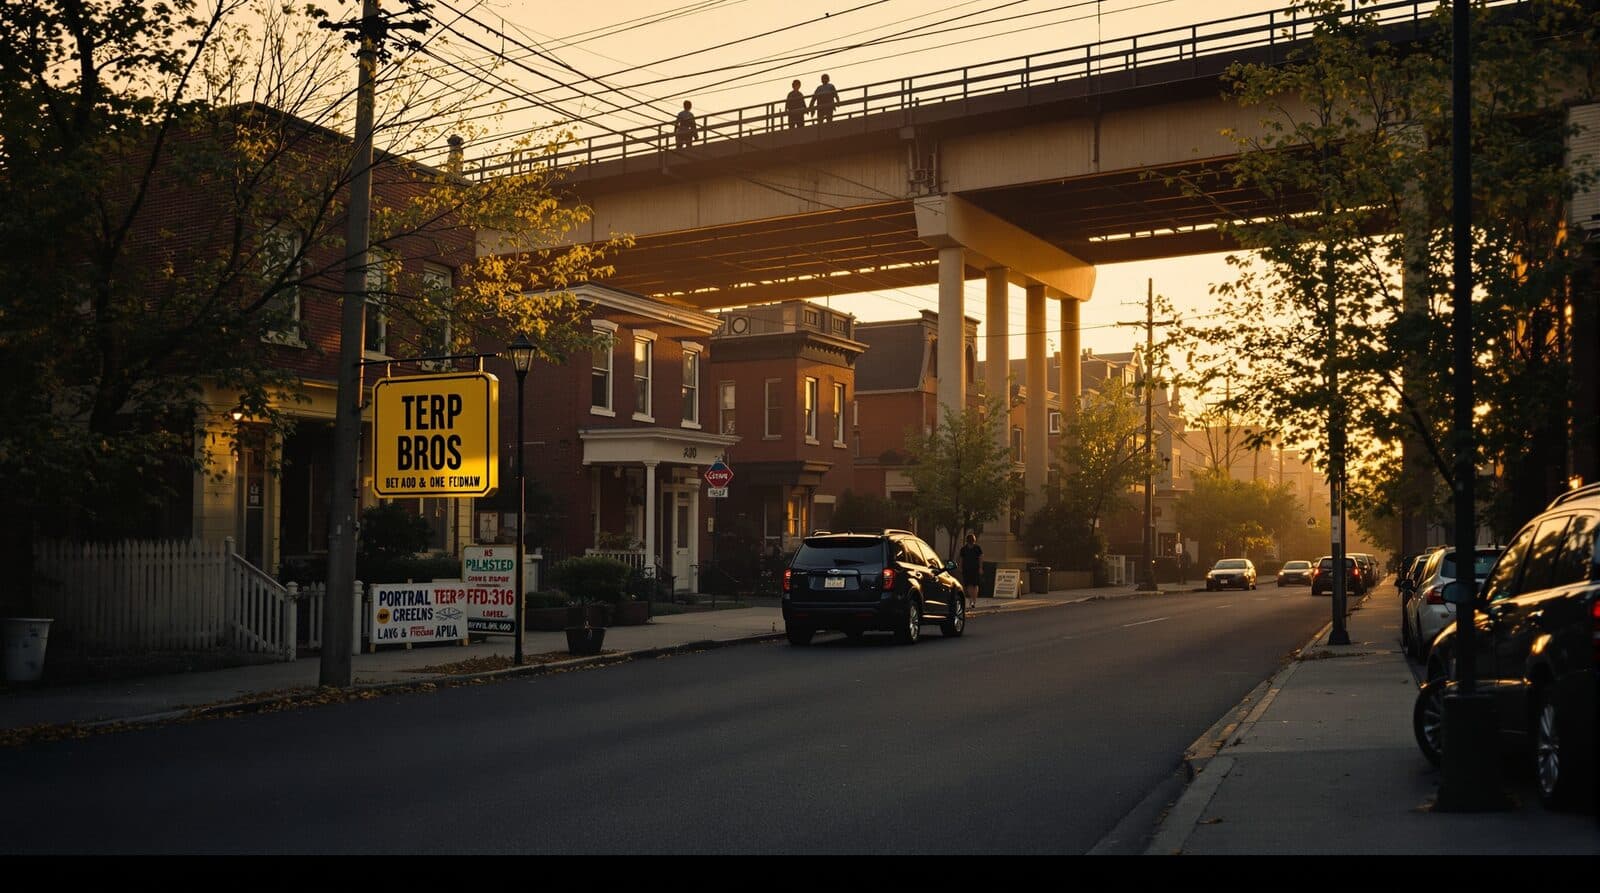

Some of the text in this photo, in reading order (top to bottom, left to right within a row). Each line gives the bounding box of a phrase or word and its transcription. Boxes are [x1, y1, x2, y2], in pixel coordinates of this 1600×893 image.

[402, 394, 462, 430] TERP
[398, 435, 461, 471] BROS
[419, 477, 426, 488] &
